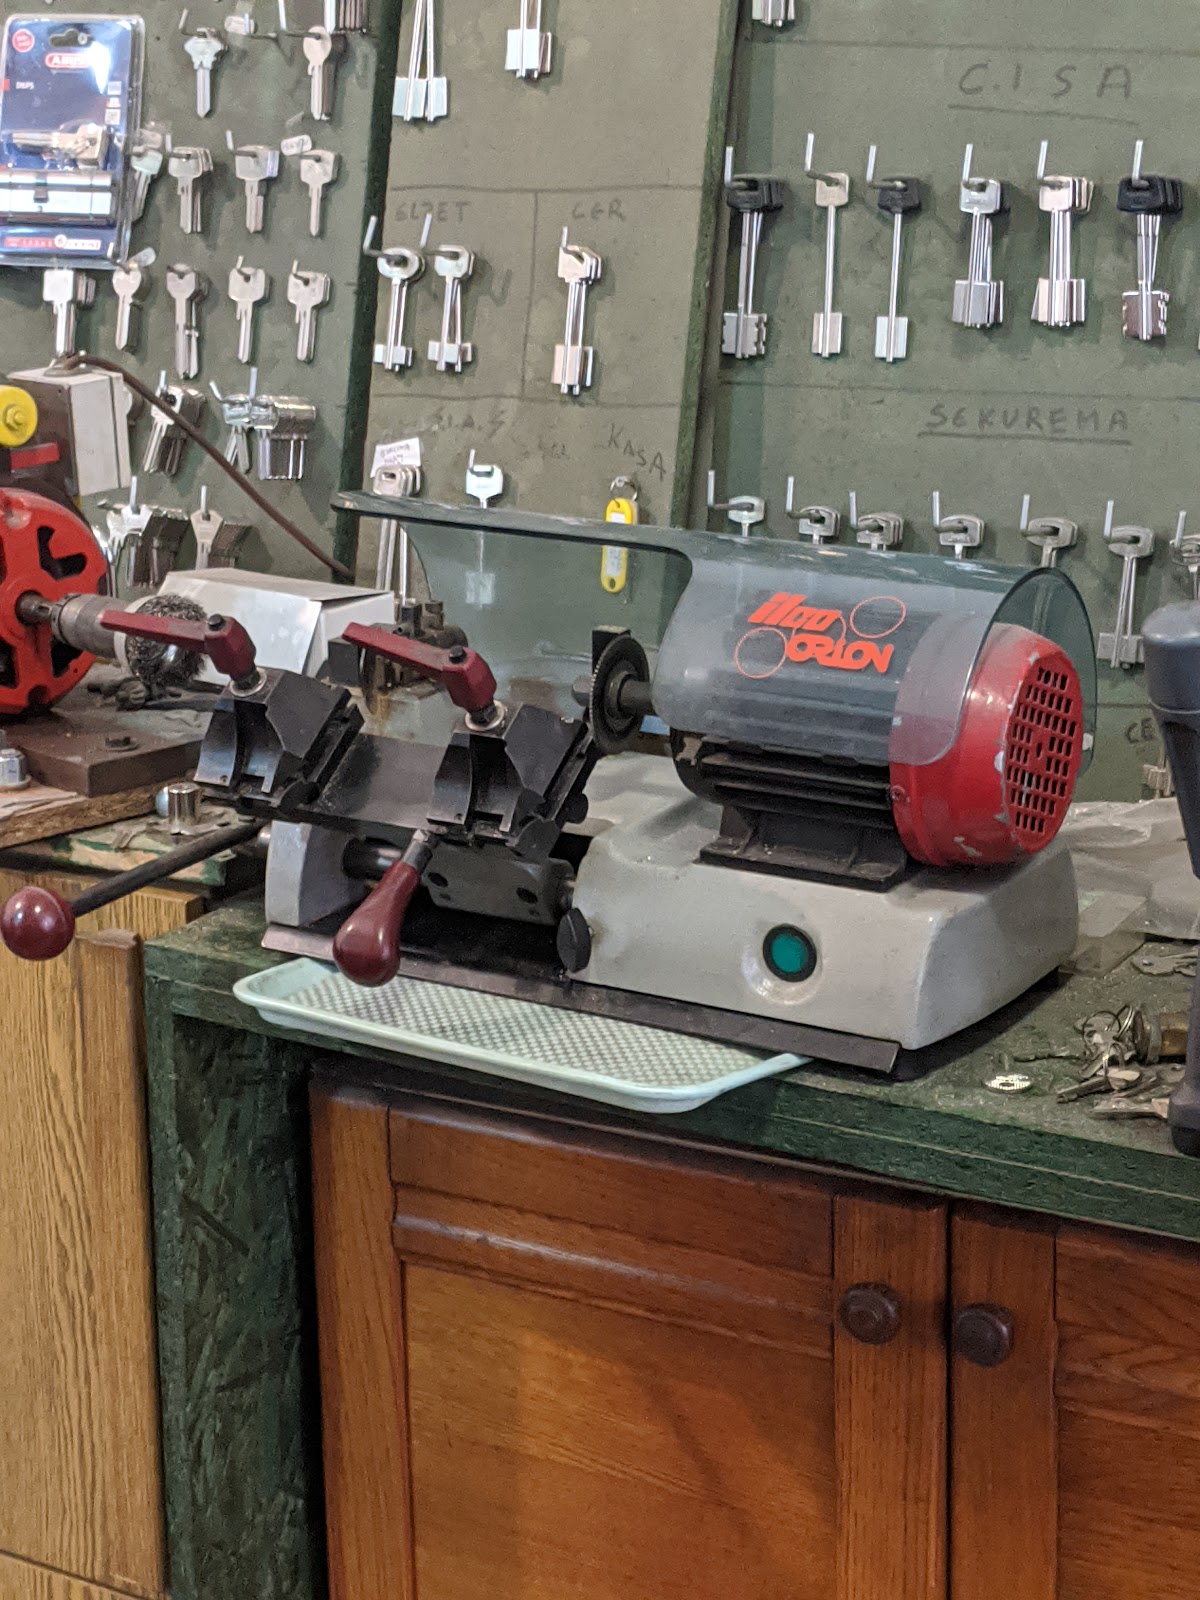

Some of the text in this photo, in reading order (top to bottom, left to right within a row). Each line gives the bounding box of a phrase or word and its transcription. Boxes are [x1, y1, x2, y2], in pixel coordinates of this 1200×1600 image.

[925, 402, 1128, 433] SEKUREMA
[607, 422, 666, 482] KASA
[786, 633, 894, 673] ORION
